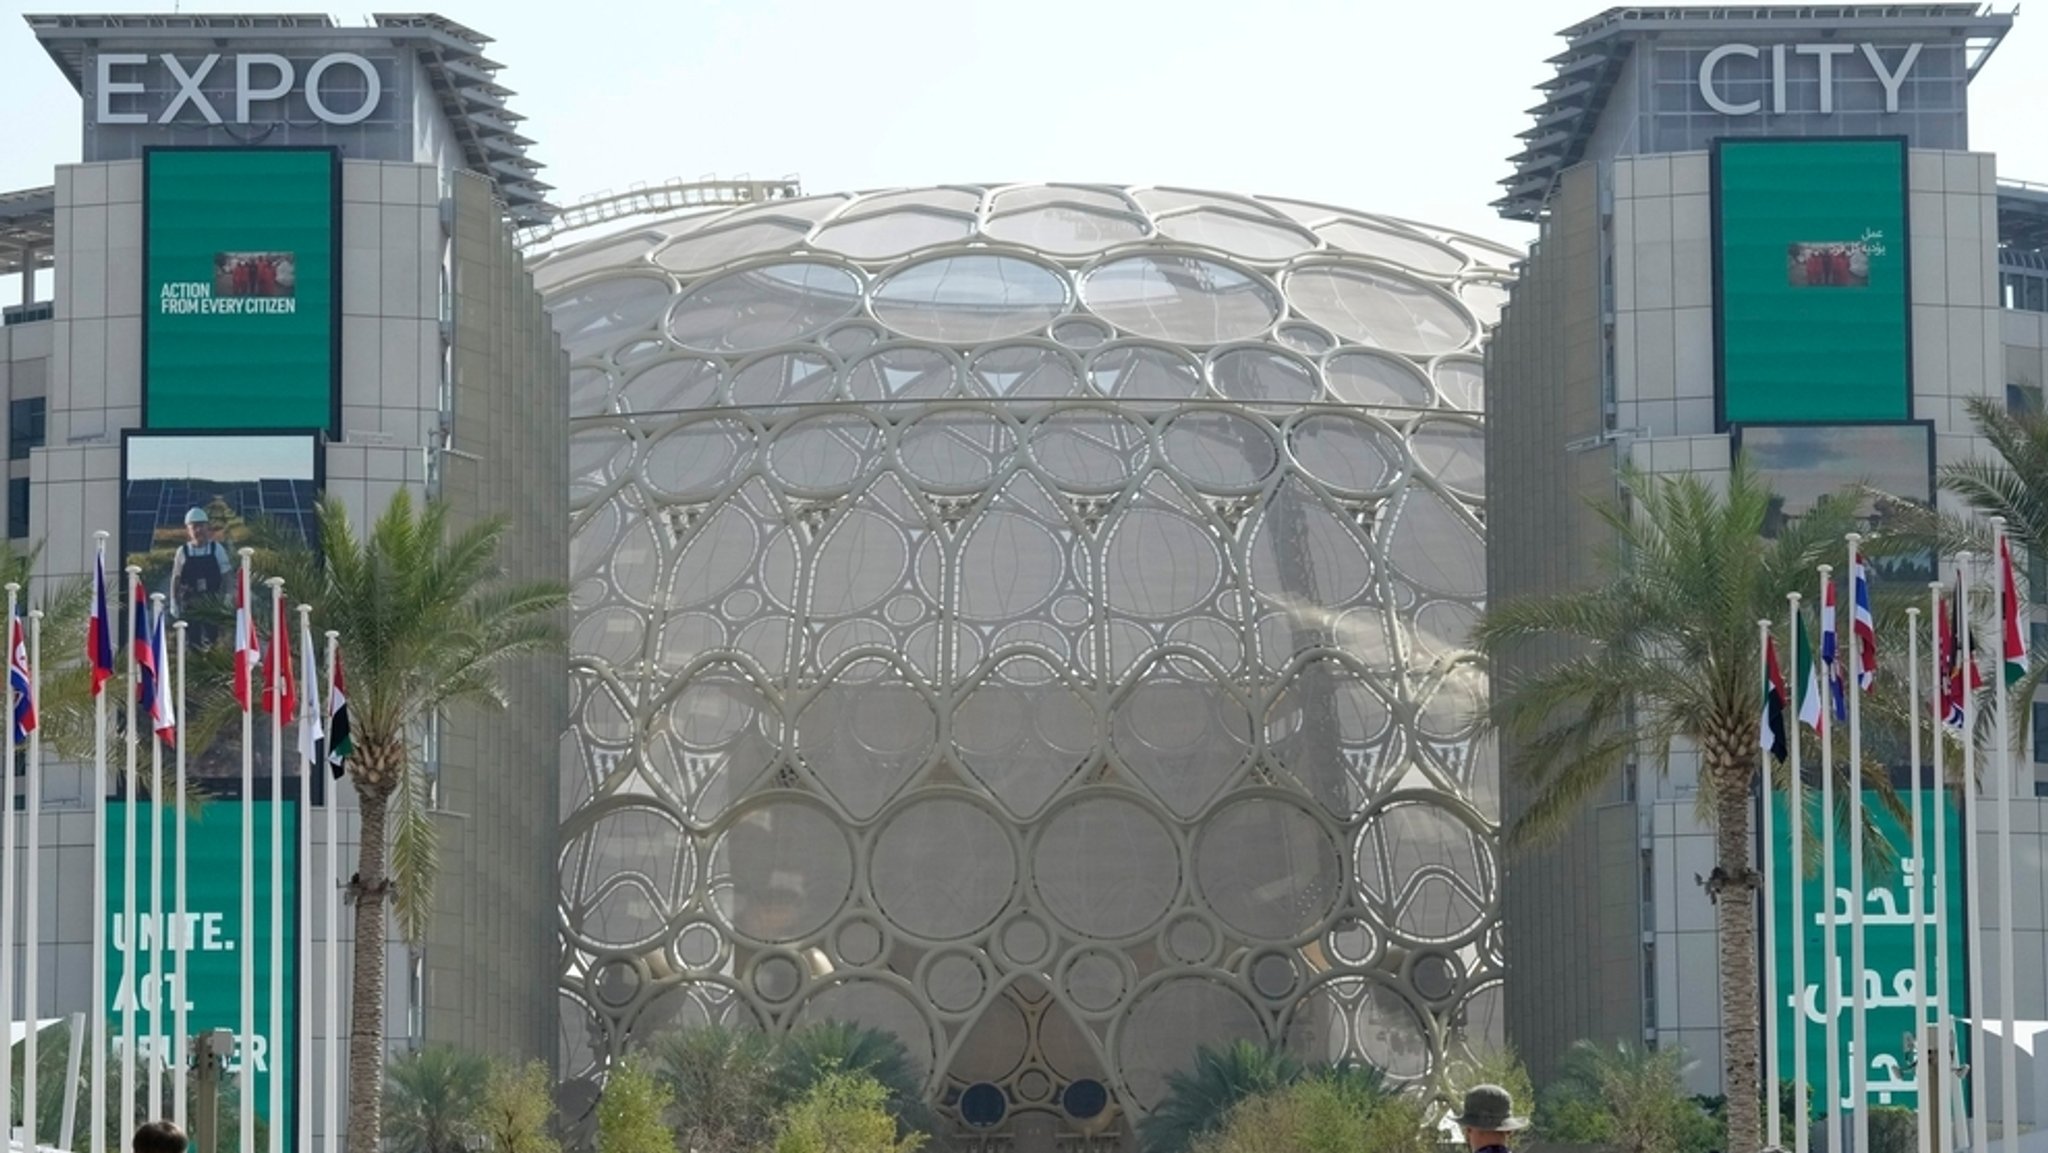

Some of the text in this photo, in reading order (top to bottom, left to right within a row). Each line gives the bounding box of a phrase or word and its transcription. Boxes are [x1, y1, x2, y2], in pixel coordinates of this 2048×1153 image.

[97, 52, 381, 124] EXPO
[1699, 43, 1923, 115] CITY
[1861, 227, 1883, 241] عمل
[160, 282, 211, 298] ACTION
[161, 298, 296, 314] FROM EVERY CITIZEN
[113, 912, 235, 950] UNITE.
